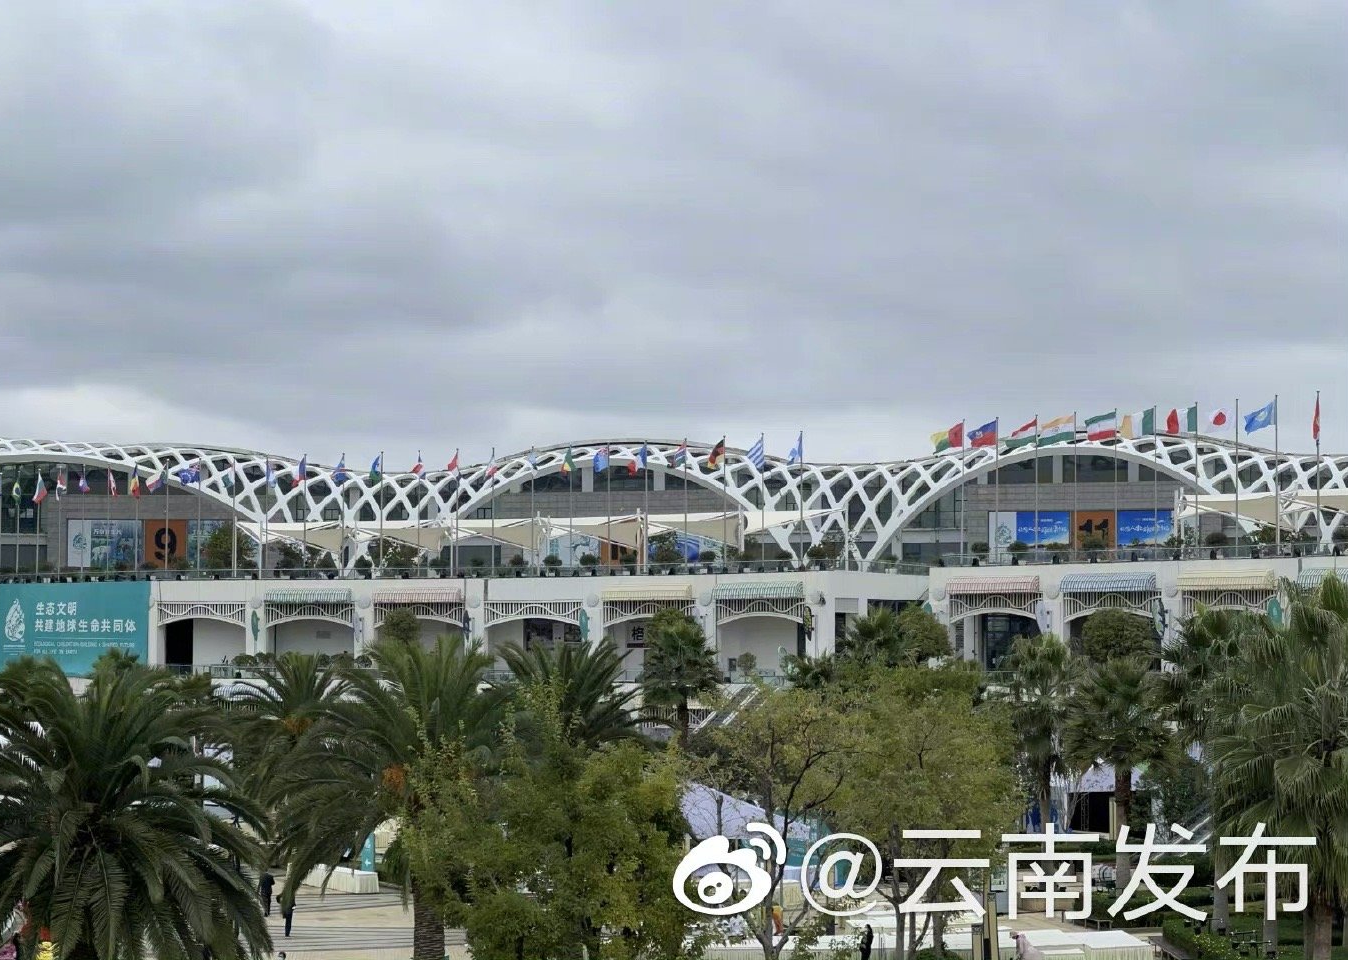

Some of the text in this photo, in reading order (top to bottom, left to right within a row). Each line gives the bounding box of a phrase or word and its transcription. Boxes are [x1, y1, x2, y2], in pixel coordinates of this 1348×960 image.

[155, 527, 177, 561] 9
[35, 601, 77, 616] 生态文明
[34, 618, 137, 633] 共建地球生命共同体
